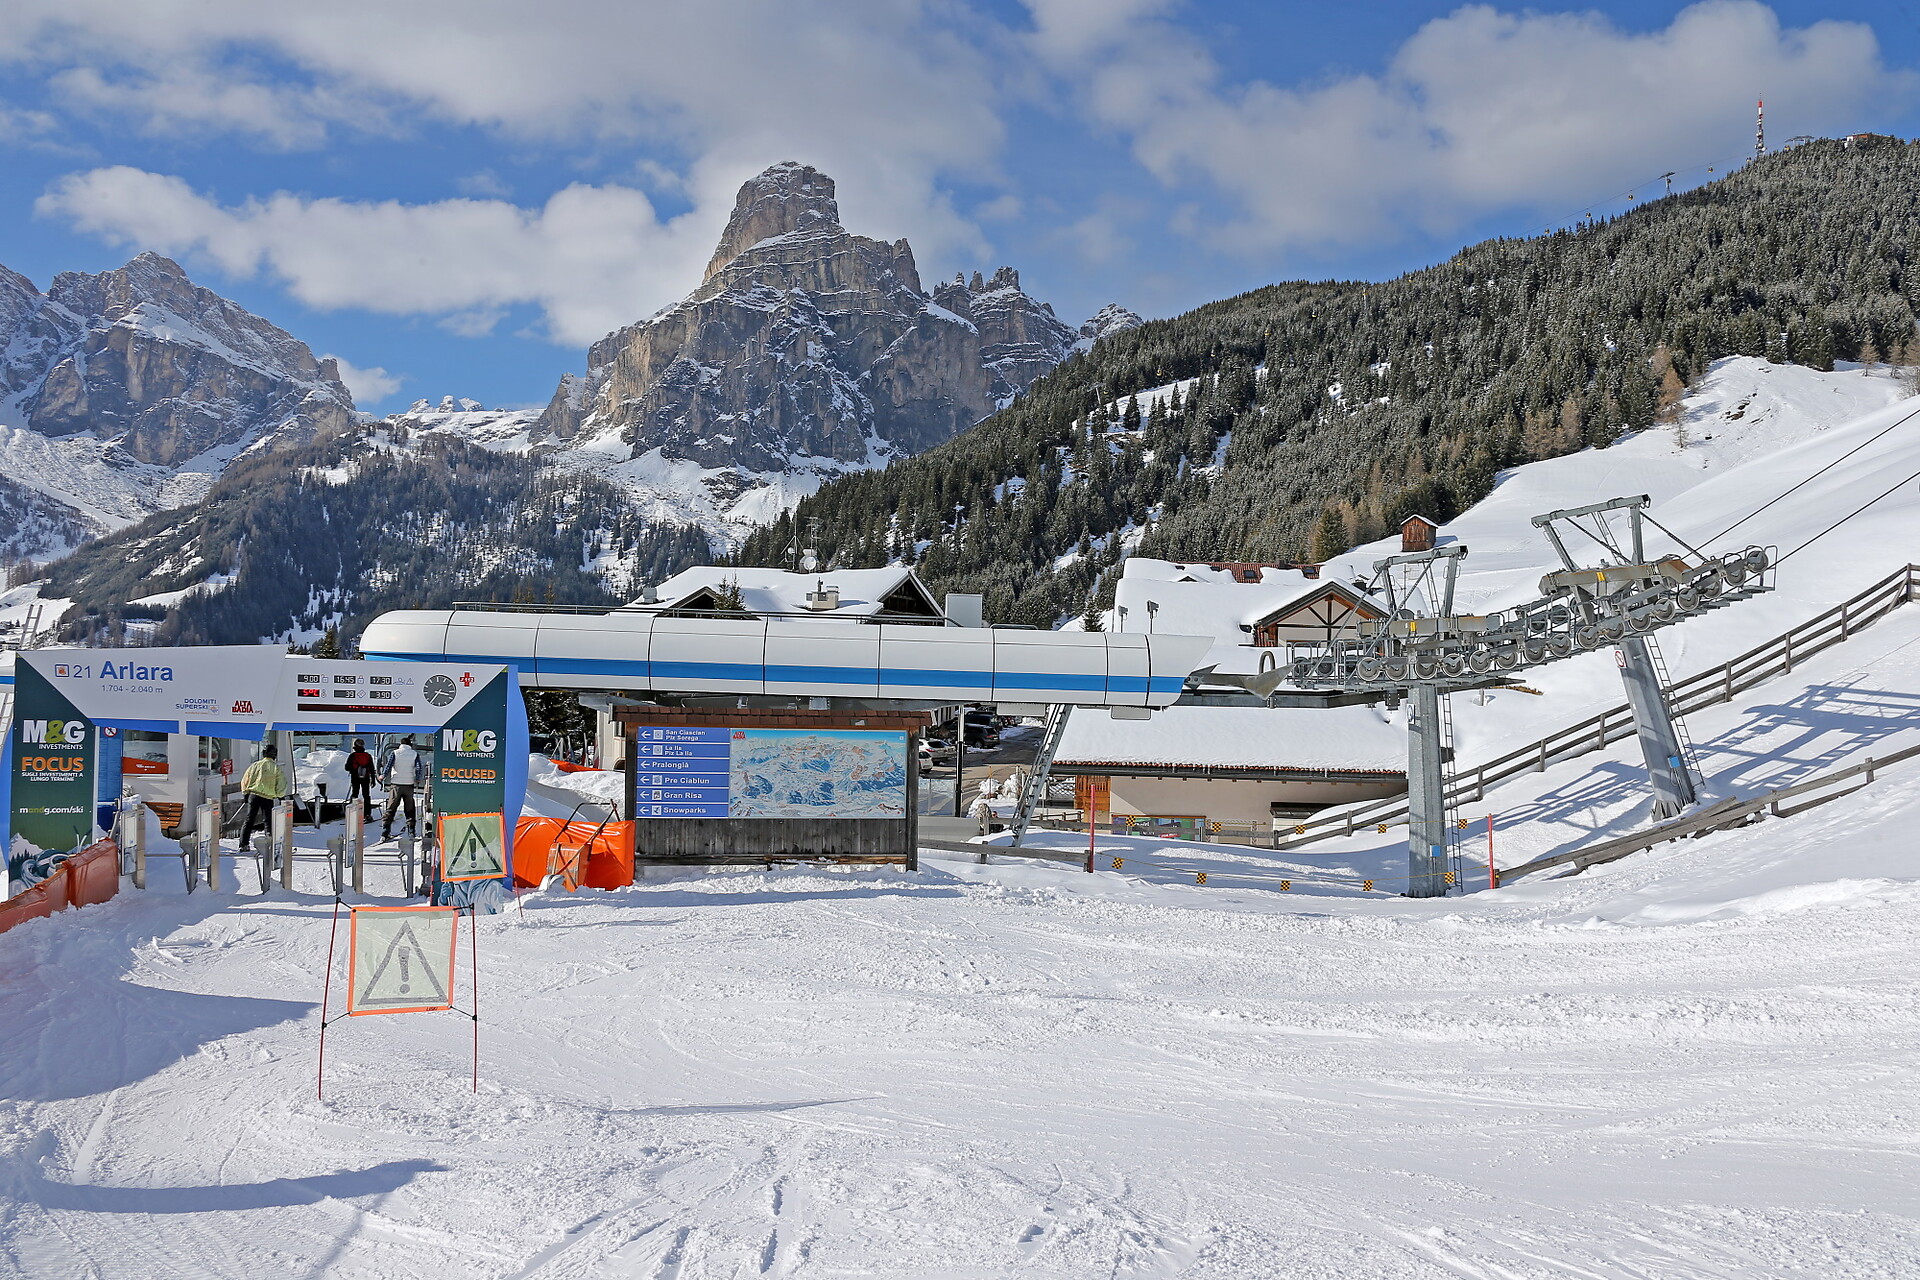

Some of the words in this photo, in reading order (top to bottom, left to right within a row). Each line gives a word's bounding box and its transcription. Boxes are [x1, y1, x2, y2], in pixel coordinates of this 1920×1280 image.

[73, 665, 92, 679] 21
[99, 660, 173, 681] Arlara
[131, 685, 153, 693] 2.040
[345, 690, 355, 698] 39
[232, 705, 254, 713] BADIA
[22, 719, 86, 743] M&G
[442, 729, 497, 752] M&G
[21, 756, 84, 772] FOCUS
[441, 768, 497, 779] FOCUSED
[20, 806, 84, 815] mandg.com/ski
